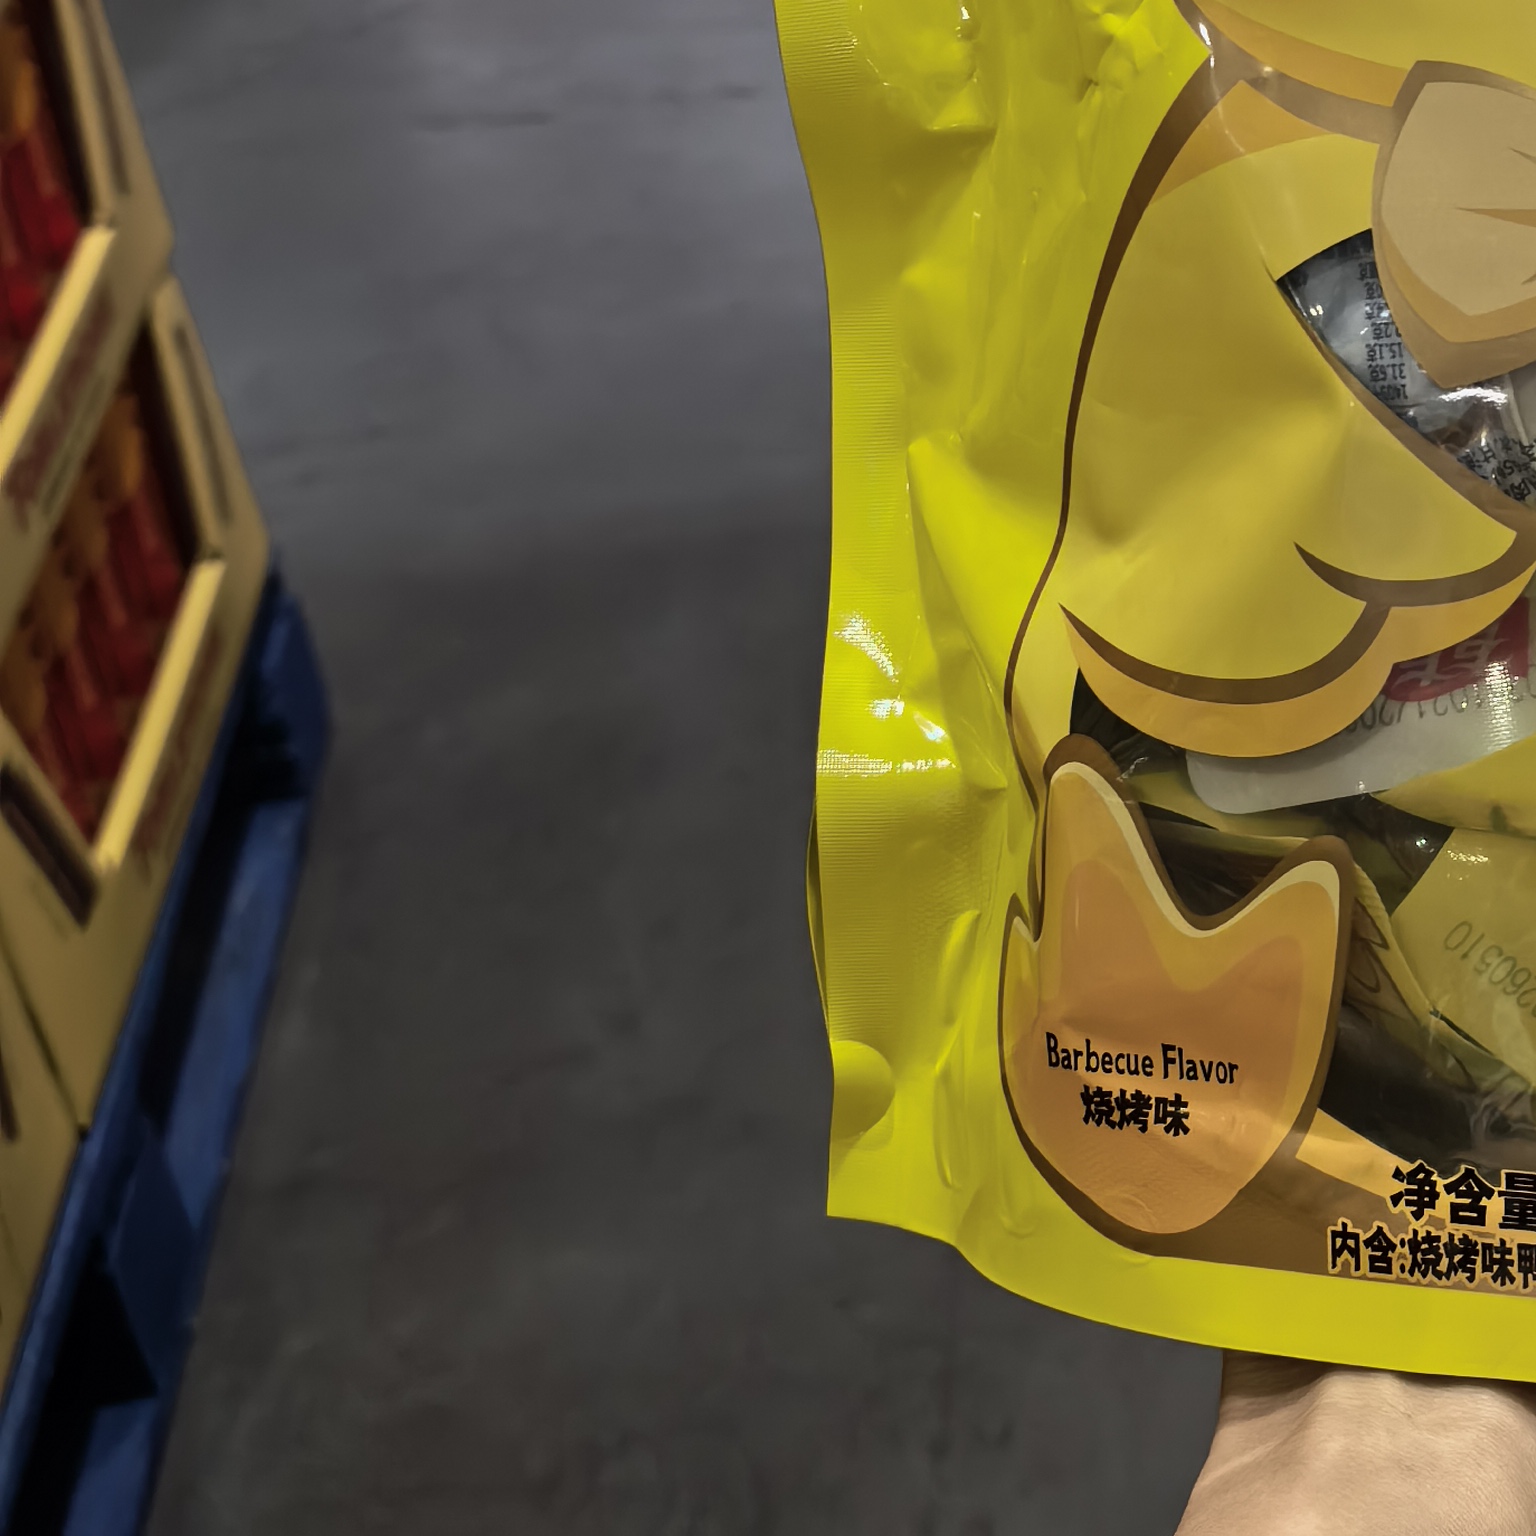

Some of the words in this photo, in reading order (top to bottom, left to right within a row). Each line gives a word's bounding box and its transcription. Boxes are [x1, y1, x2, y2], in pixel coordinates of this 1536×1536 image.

[1046, 1031, 1154, 1077] Barbecue
[1161, 1042, 1239, 1084] Flavor
[1080, 1084, 1191, 1137] 烧烤味
